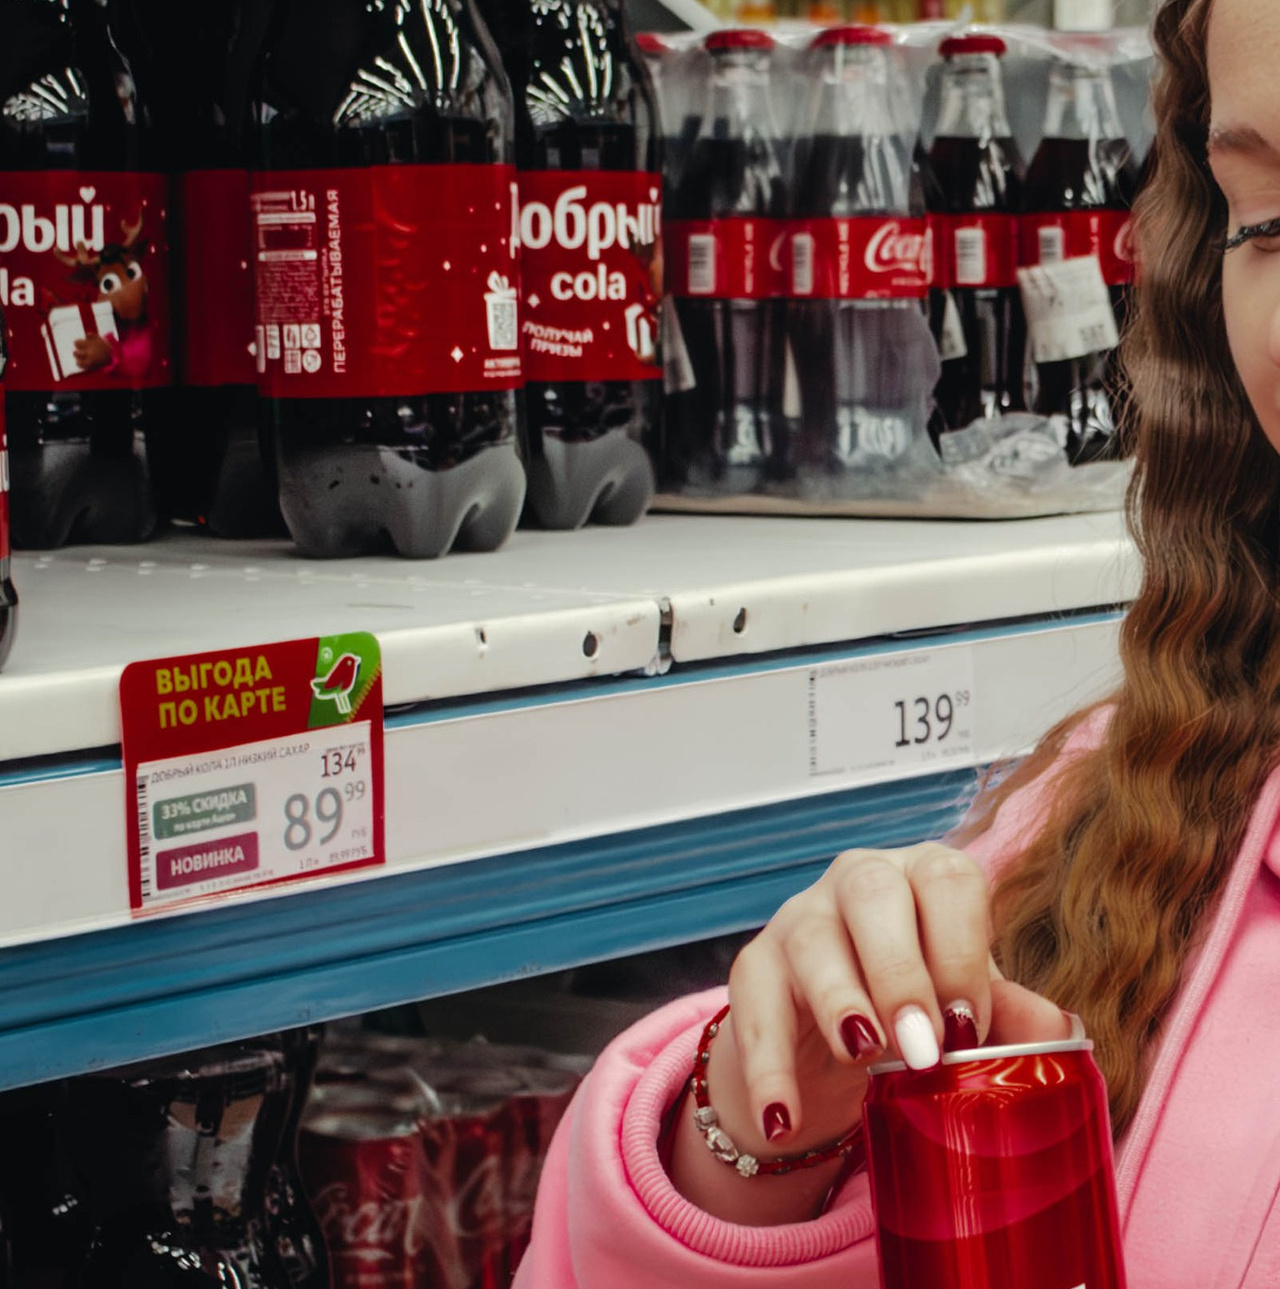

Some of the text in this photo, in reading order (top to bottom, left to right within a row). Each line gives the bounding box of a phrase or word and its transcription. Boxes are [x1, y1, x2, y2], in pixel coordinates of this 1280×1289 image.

[327, 189, 346, 373] ПЕРЕРАБАТЫВАЕМАЯ
[551, 263, 626, 300] cola
[522, 321, 593, 344] ПОЛУЧАЙ
[531, 338, 582, 357] ПРИЗЫ
[155, 655, 273, 695] ВЫГОДА
[159, 686, 287, 729] ПО КАРТЕ
[895, 694, 953, 747] 139
[151, 761, 195, 784] ДОБРЫЙ
[195, 756, 222, 775] КОЛА
[238, 748, 277, 766] НИЗКИЙ
[321, 750, 356, 778] 134
[161, 789, 247, 820] 33% СКИДКА
[283, 786, 344, 852] 89
[170, 845, 244, 876] НОВИНКА
